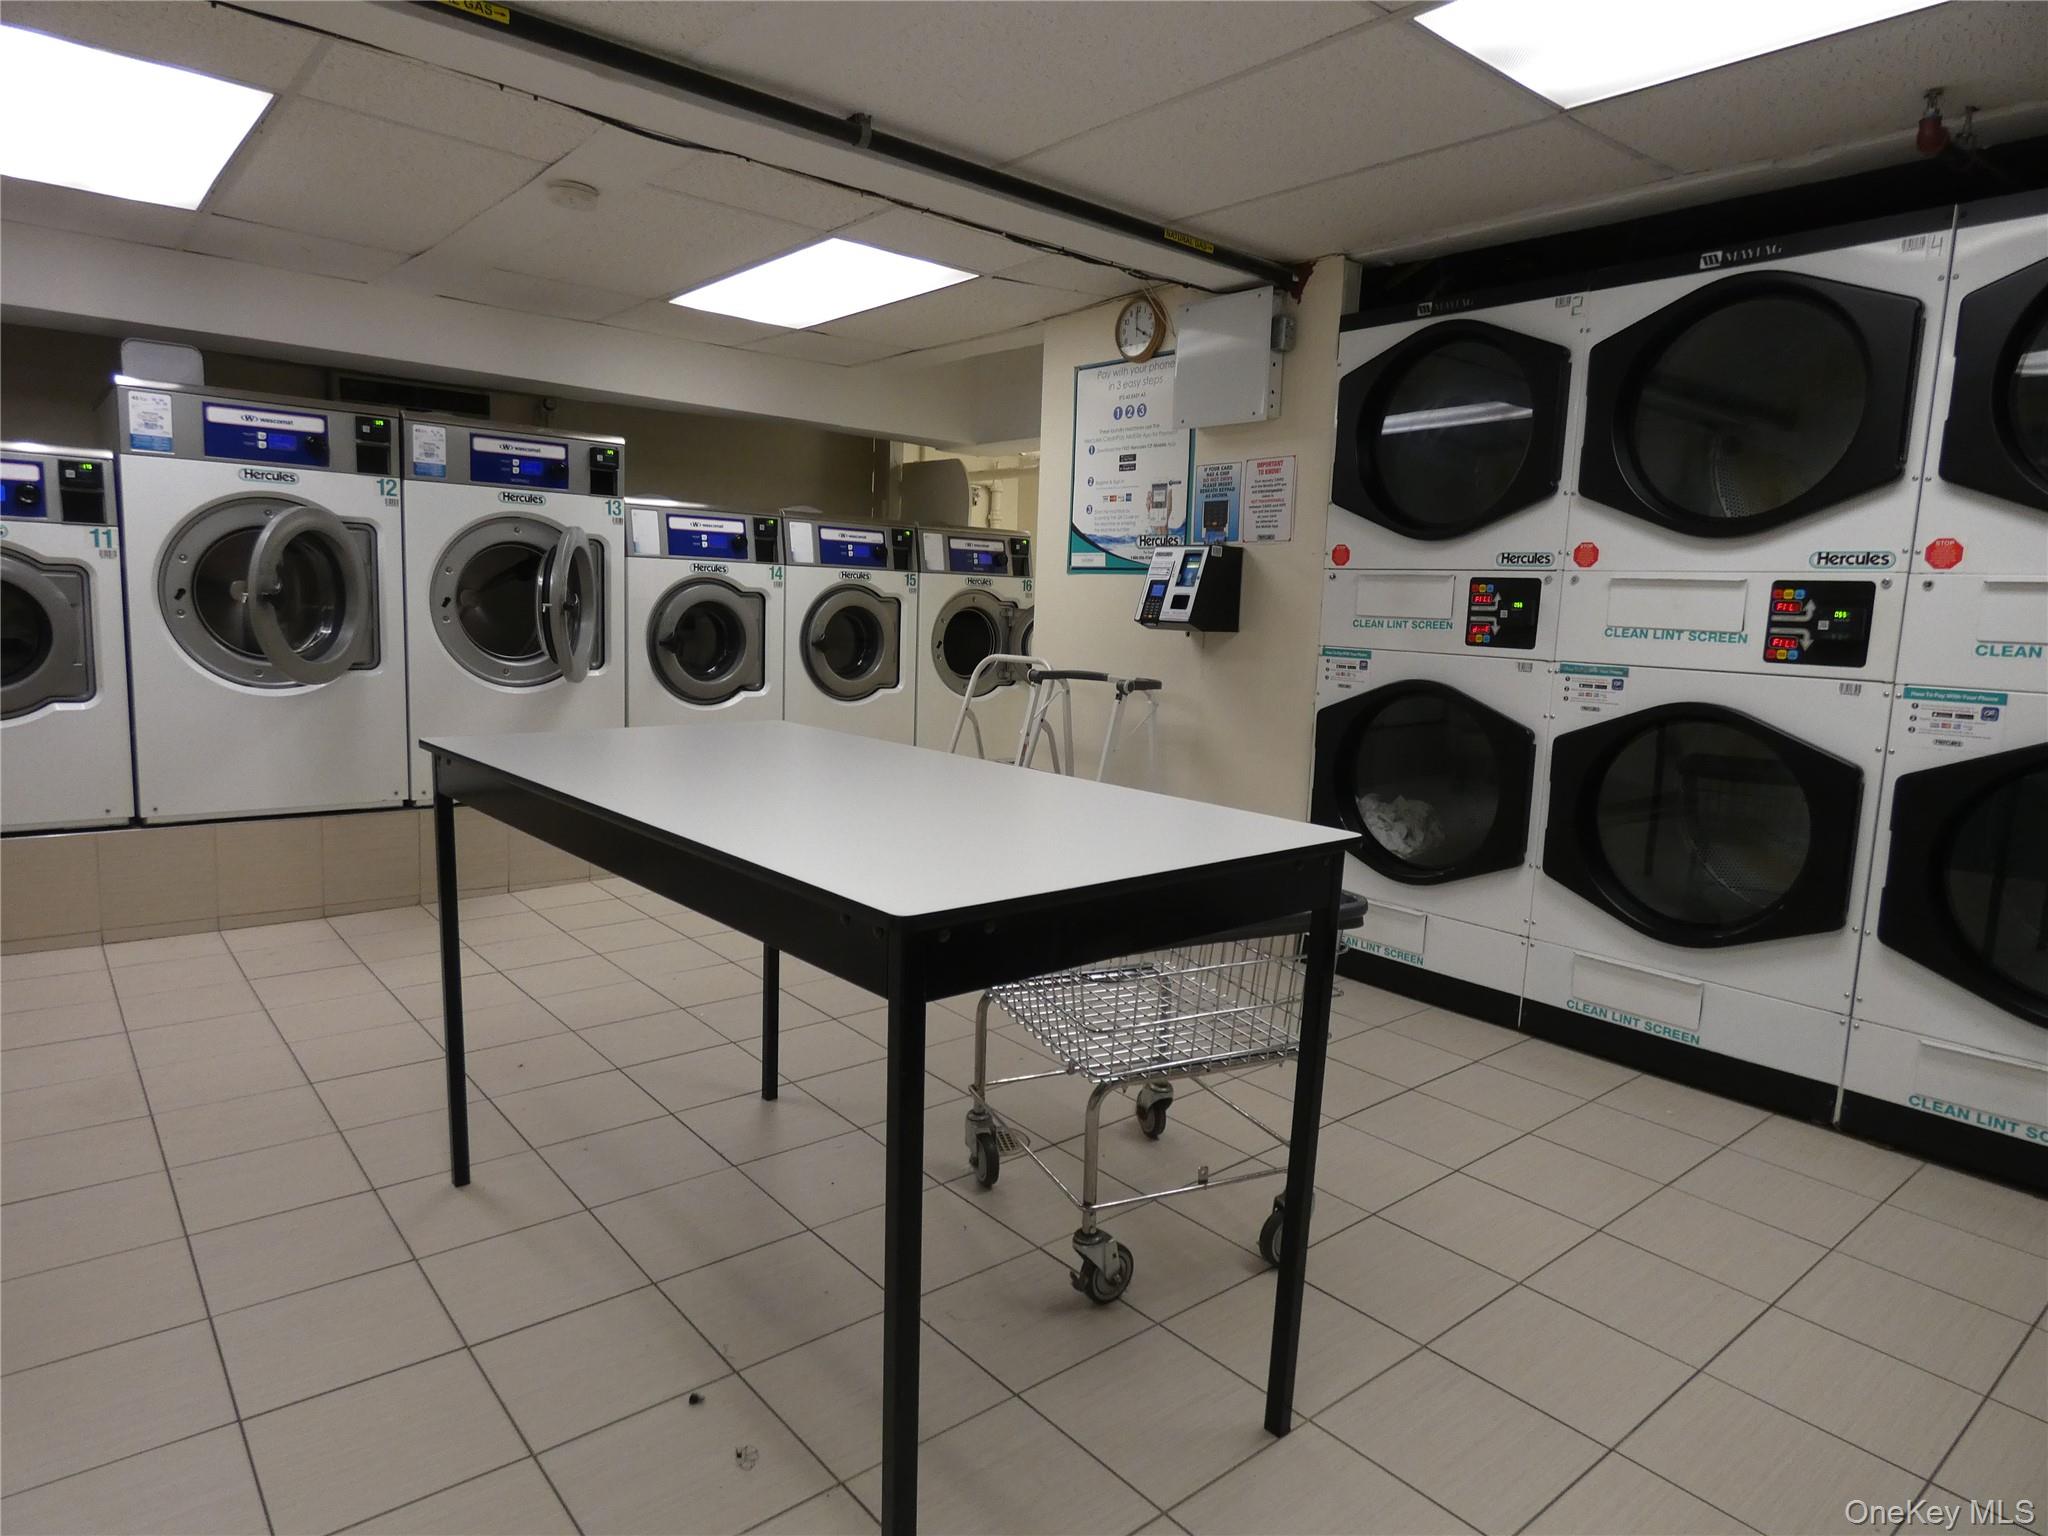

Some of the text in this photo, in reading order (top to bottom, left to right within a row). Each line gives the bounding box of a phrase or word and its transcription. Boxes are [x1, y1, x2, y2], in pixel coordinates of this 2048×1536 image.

[464, 0, 493, 16] GAS
[1097, 360, 1176, 380] Pay with your phone
[1108, 382, 1115, 391] in
[1122, 379, 1141, 390] easy
[1142, 375, 1163, 387] steps
[1257, 460, 1284, 468] IMPORTANT
[244, 468, 296, 483] Hercules
[377, 479, 398, 496] 12
[502, 492, 544, 505] Hercules
[605, 500, 622, 516] 13
[89, 528, 113, 549] 11
[1140, 535, 1179, 547] Hercules
[1500, 552, 1551, 565] Hercules
[1816, 551, 1890, 566] Hercules
[693, 563, 727, 573] Hercules
[769, 566, 783, 580] 14
[841, 571, 870, 580] Hercules
[904, 574, 916, 587] 15
[967, 577, 992, 586] Hercules
[1022, 579, 1032, 592] 16
[1353, 618, 1453, 630] CLEAN LINT SCREEN
[1604, 627, 1748, 644] CLEAN LINT SCREEN
[1975, 644, 2042, 659] CLEAN
[1360, 940, 1381, 953] LINT
[1384, 947, 1424, 966] SCREEN
[1566, 999, 1701, 1046] CLEAN LINT SCREEN
[1908, 1095, 1970, 1120] CLEAN
[1976, 1113, 2020, 1133] LINT
